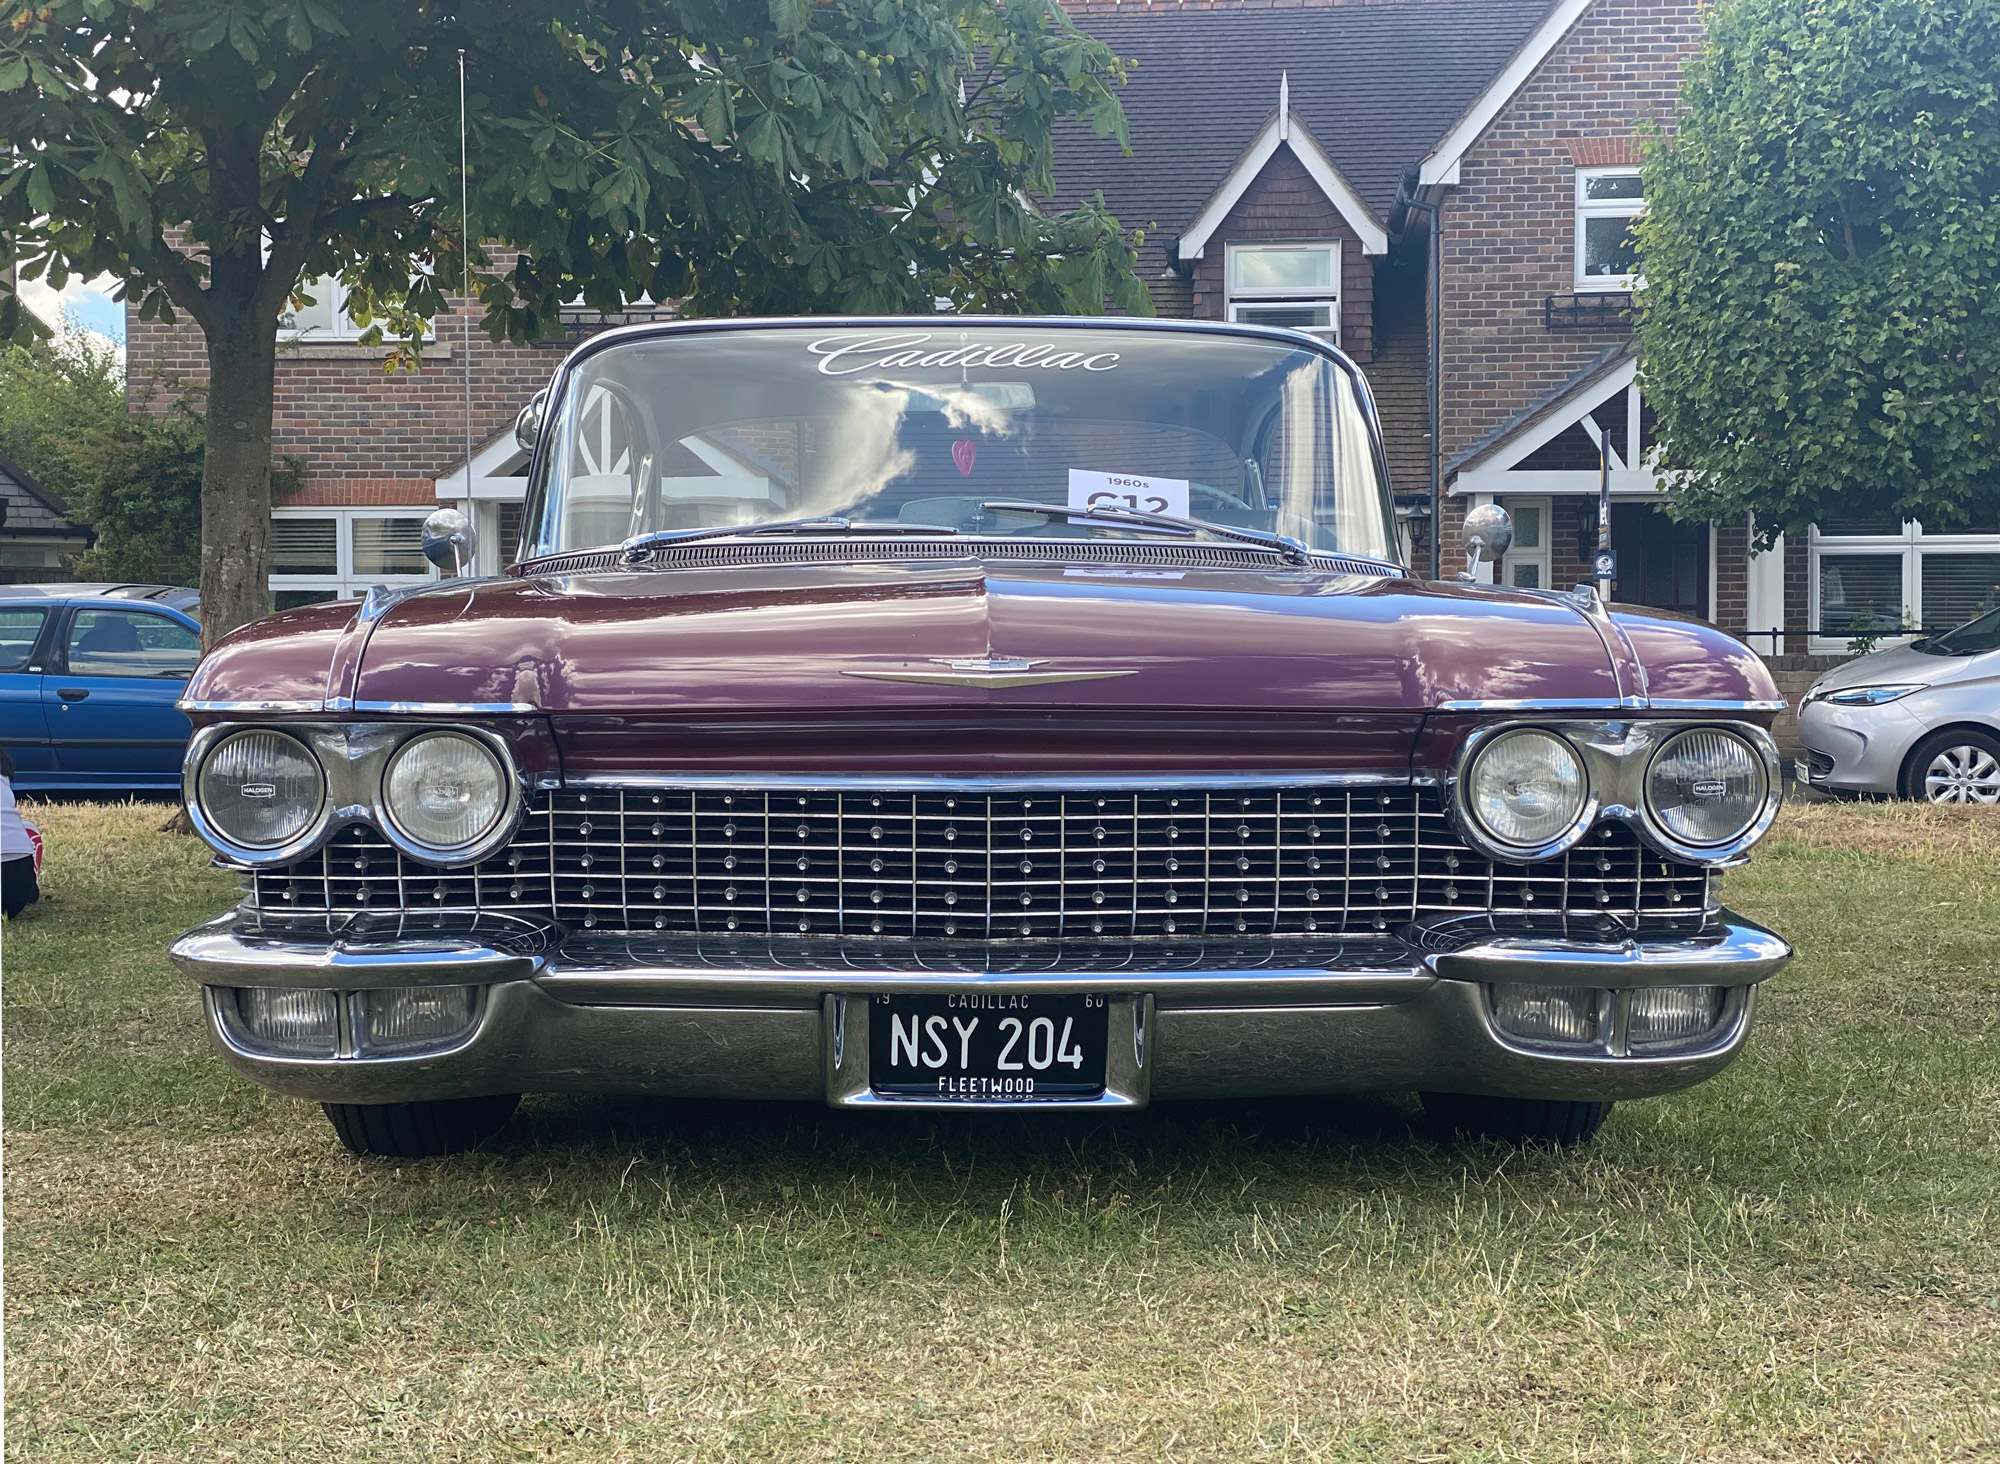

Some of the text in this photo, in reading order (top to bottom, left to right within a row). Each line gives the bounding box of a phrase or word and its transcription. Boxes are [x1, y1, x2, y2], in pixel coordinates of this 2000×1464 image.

[807, 333, 1121, 375] Cadillac
[1107, 477, 1150, 488] 1960s
[948, 993, 1029, 1009] CADILLAC
[1085, 994, 1104, 1008] 60
[891, 1013, 1084, 1070] NSY 204
[938, 1076, 1034, 1093] FLEETWOOD
